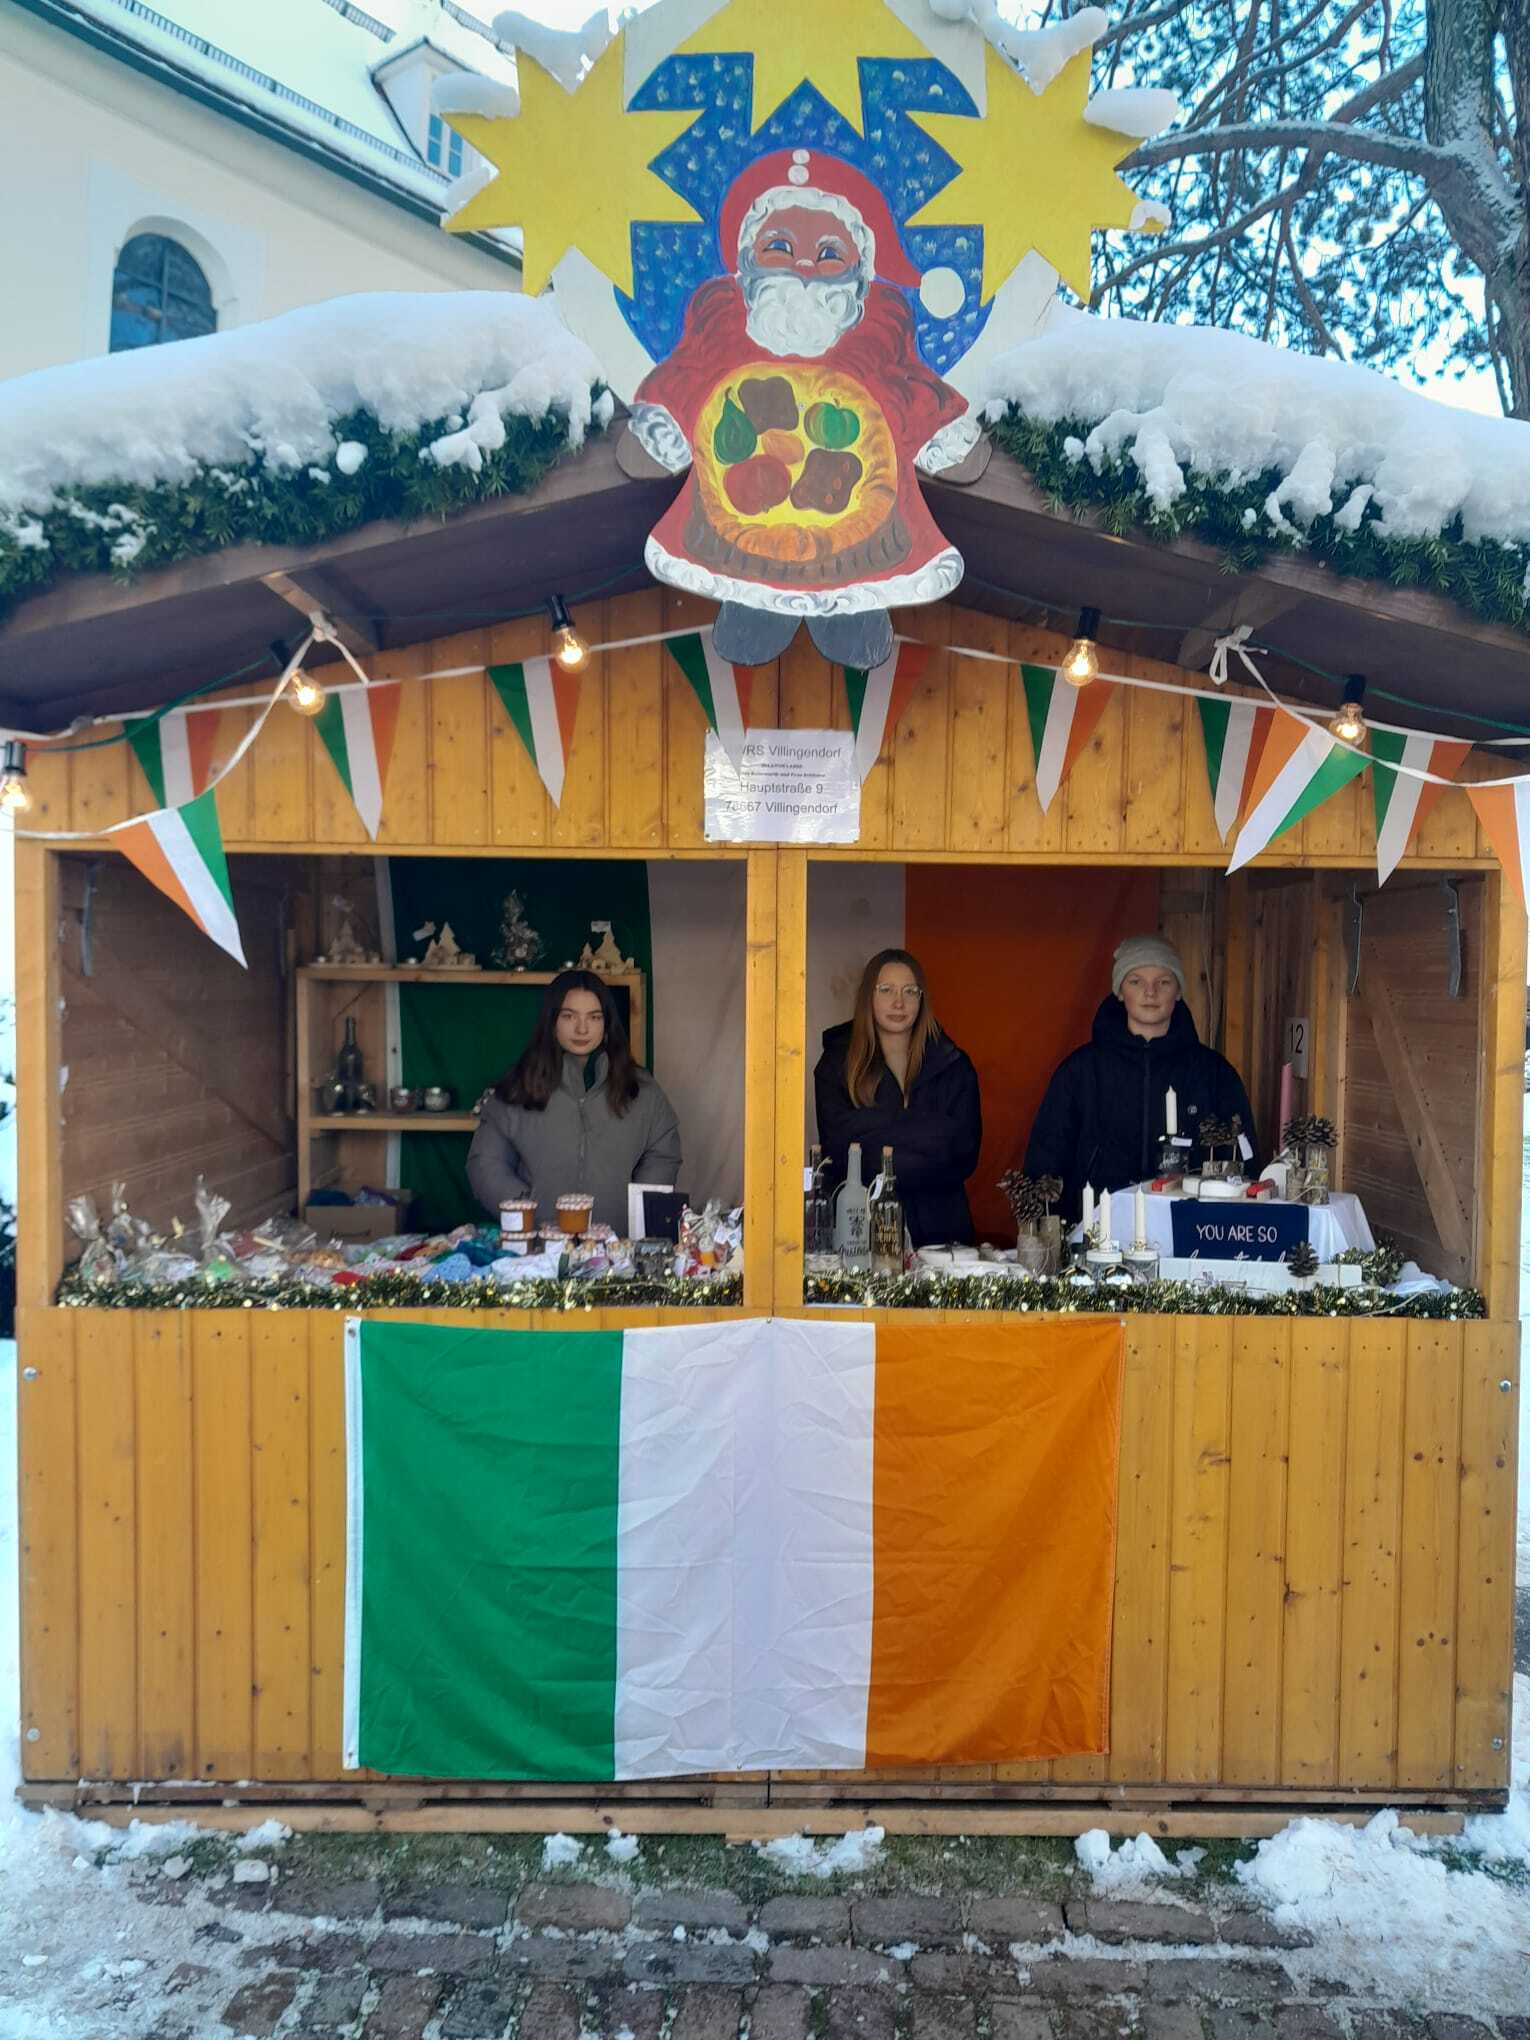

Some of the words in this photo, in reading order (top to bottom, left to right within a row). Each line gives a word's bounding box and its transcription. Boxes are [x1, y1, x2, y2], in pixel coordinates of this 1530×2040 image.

[742, 744, 765, 757] RS
[768, 745, 842, 761] Villingendorf
[740, 782, 812, 795] Hauptstraße
[816, 783, 824, 794] 9
[765, 802, 839, 816] Villingendorf
[1289, 1023, 1304, 1054] 12
[1196, 1224, 1224, 1241] YOU
[1228, 1225, 1254, 1243] ARE
[1257, 1226, 1277, 1244] SO
